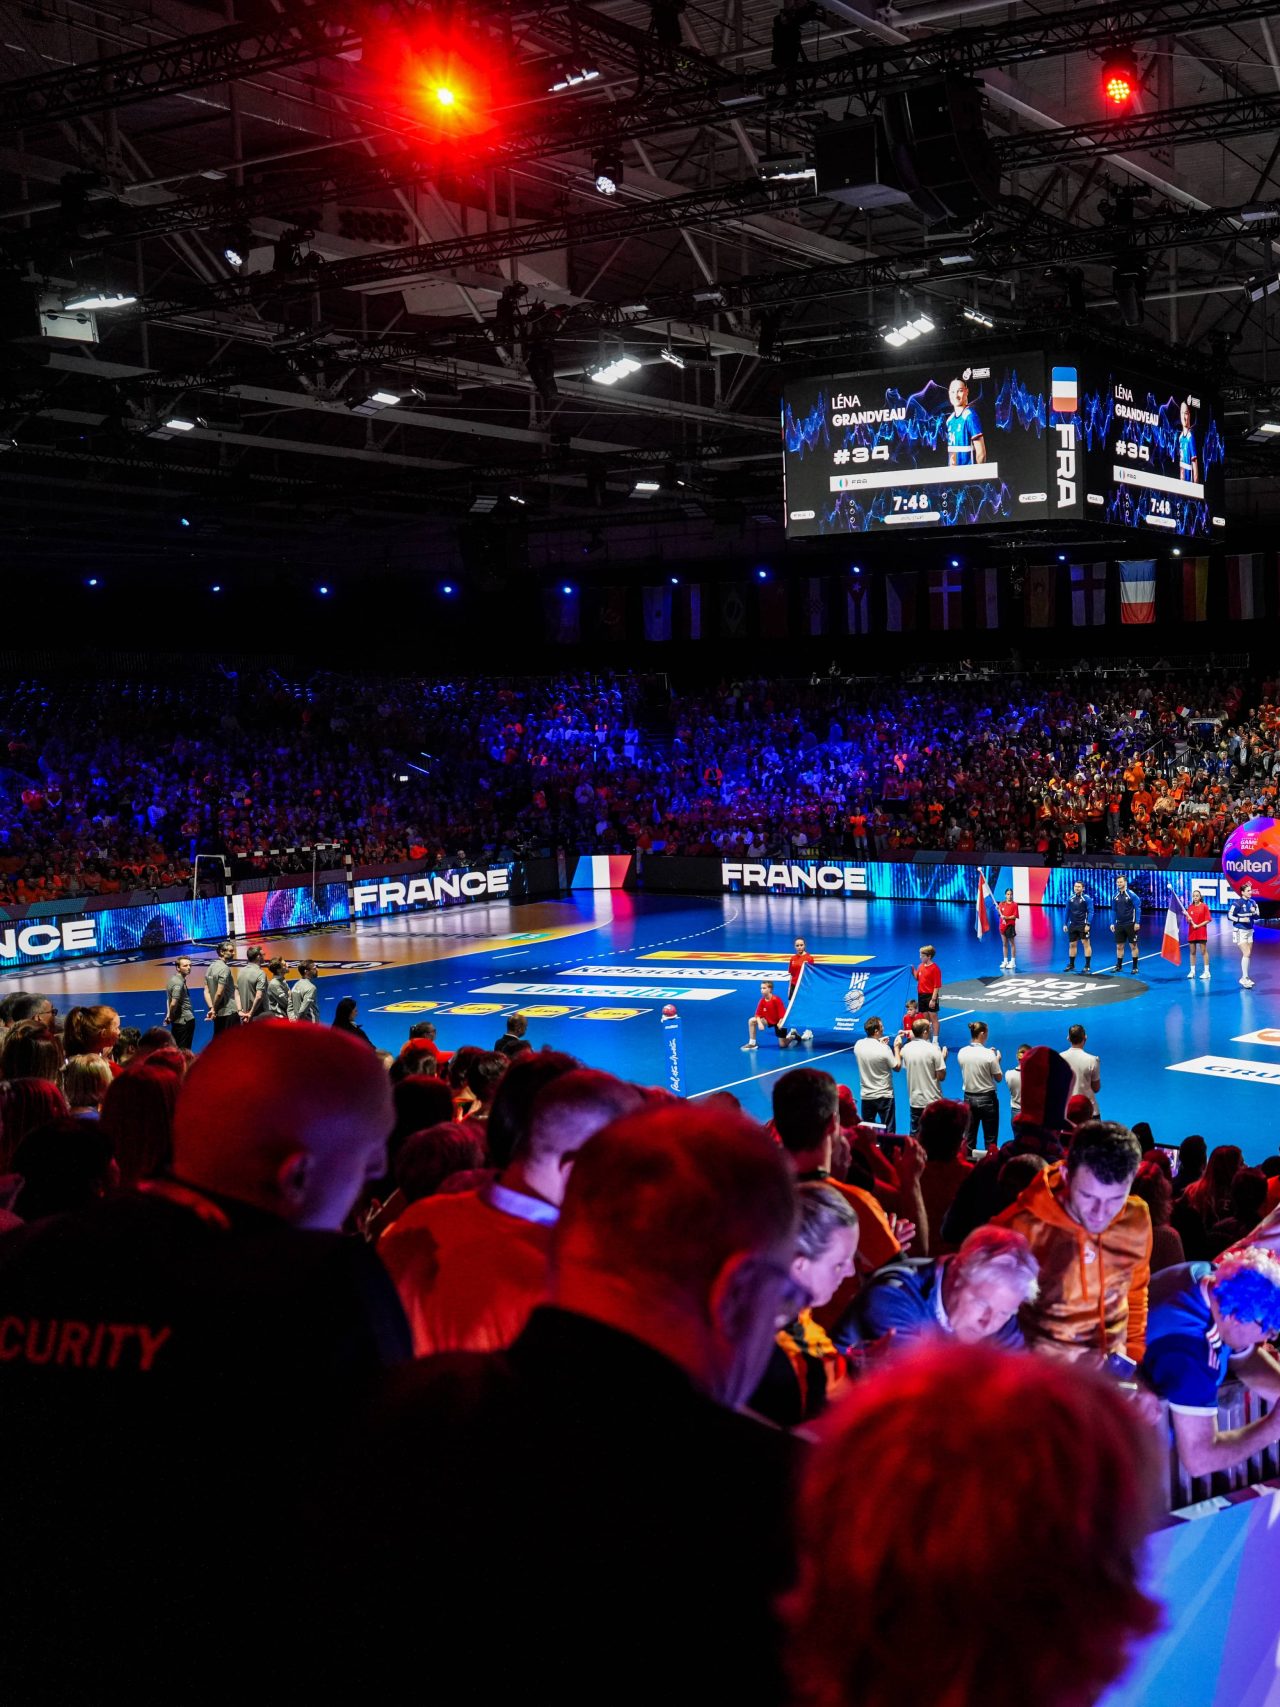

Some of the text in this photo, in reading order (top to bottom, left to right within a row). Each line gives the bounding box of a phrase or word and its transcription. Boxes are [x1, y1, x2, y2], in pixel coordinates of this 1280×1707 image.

[831, 394, 861, 410] LÉNA
[1115, 384, 1134, 402] LÉNA
[832, 408, 906, 427] GRANDVEAU
[1115, 404, 1160, 426] GRANDVEAU
[1056, 424, 1077, 508] FRA
[893, 494, 929, 511] 7:48
[1151, 498, 1171, 514] 7:48
[1226, 859, 1272, 873] molten
[722, 863, 867, 890] FRANCE
[353, 868, 509, 912] FRANCE
[0, 919, 97, 958] NCE
[985, 978, 1120, 992] play
[0, 1315, 172, 1370] CURITY
